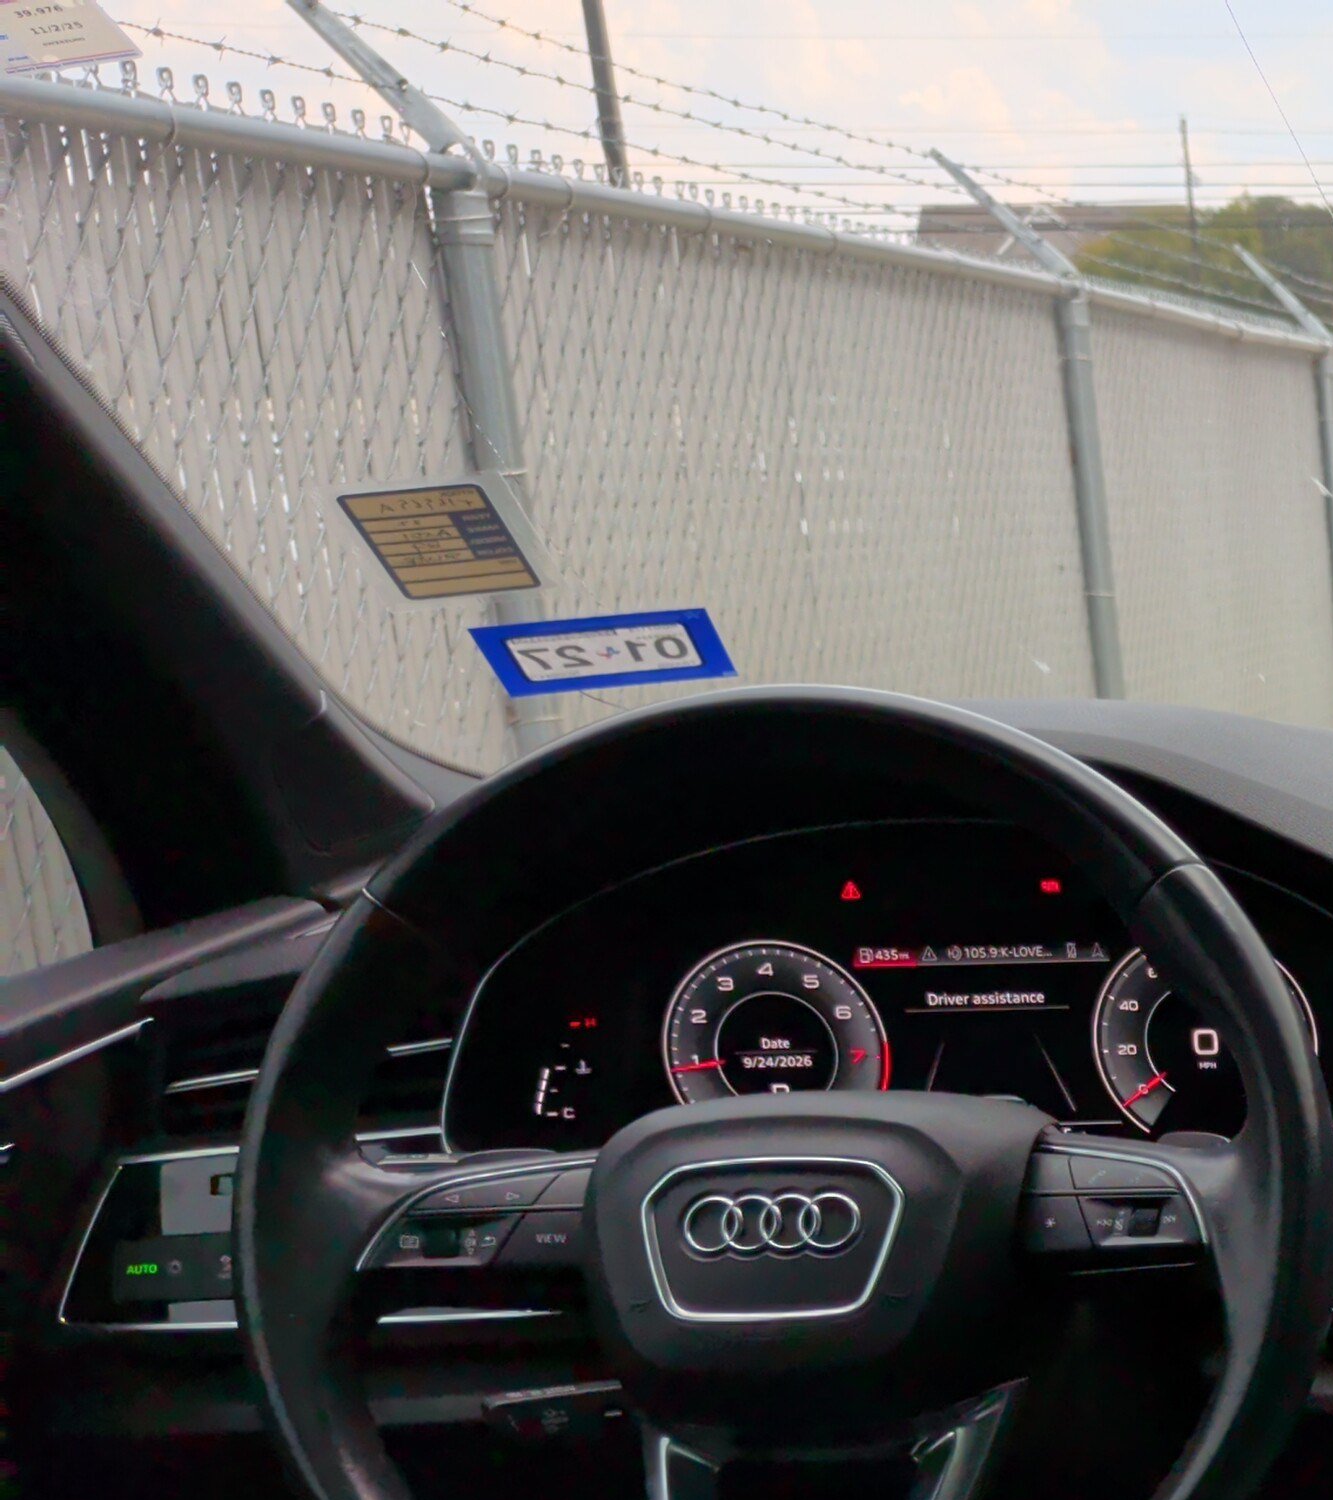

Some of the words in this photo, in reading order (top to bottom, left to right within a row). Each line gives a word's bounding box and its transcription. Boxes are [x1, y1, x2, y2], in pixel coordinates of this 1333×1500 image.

[875, 949, 898, 961] 435
[757, 963, 773, 976] 4
[717, 977, 734, 991] 3
[803, 975, 820, 989] 5
[927, 992, 970, 1005] Driver
[972, 991, 1045, 1005] assistance
[834, 1005, 852, 1020] 6
[1119, 1000, 1139, 1012] 40
[691, 1009, 708, 1024] 2
[760, 1036, 790, 1050] Date
[1193, 1028, 1219, 1055] 0
[850, 1047, 867, 1064] 7
[1118, 1044, 1137, 1056] 20
[743, 1055, 813, 1069] 9/24/2026
[562, 1107, 576, 1119] C
[126, 1263, 158, 1276] AUTO
